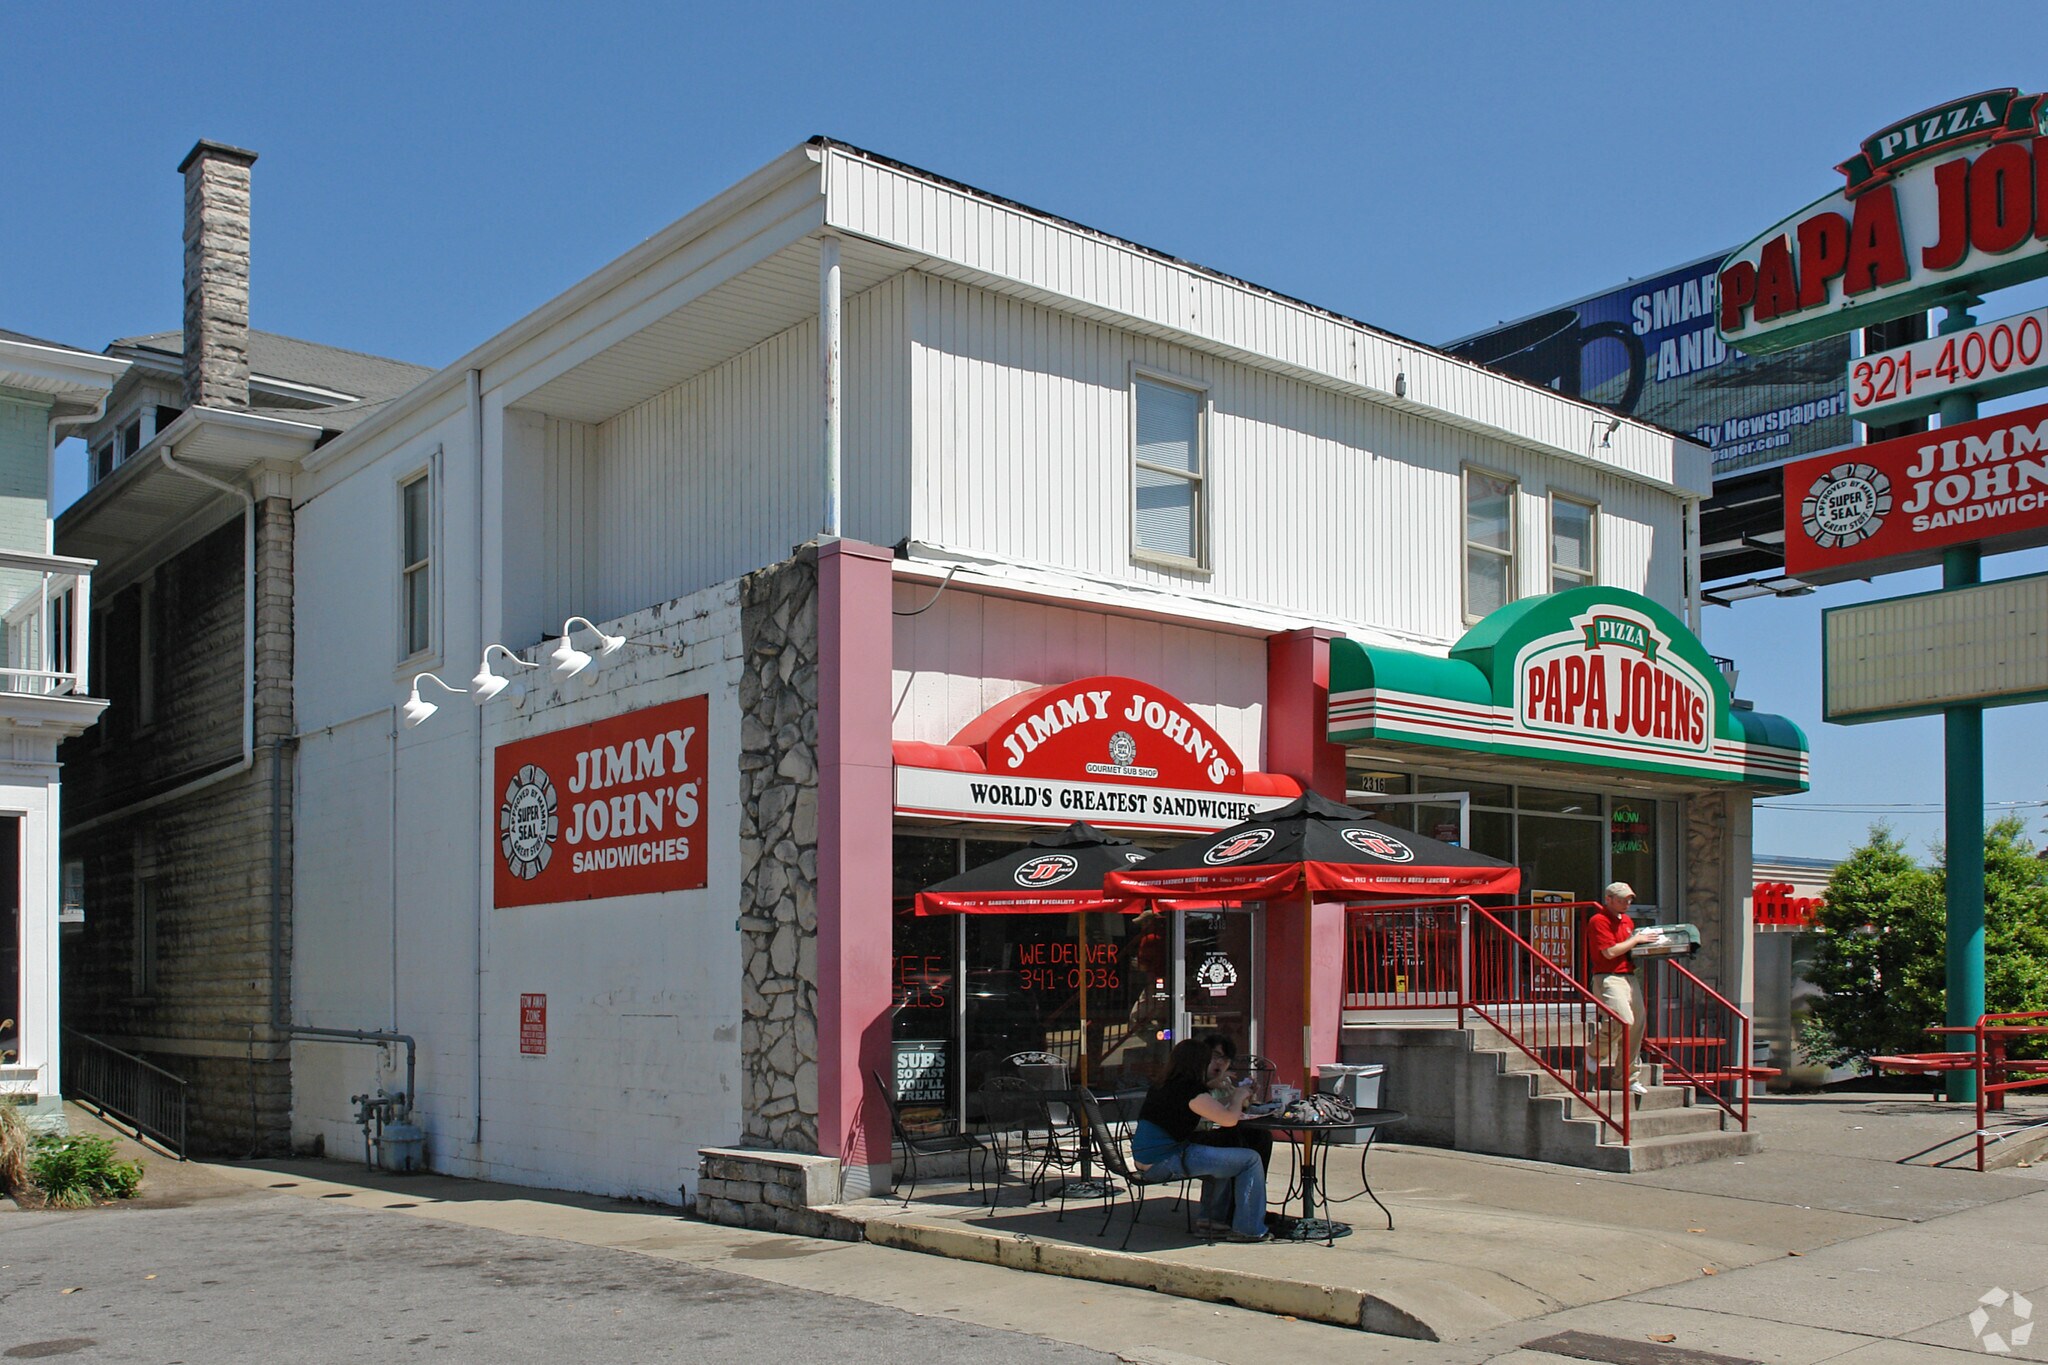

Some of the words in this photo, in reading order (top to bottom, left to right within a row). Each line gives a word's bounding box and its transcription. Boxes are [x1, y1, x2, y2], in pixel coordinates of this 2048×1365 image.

[1877, 101, 1996, 160] PIZZA
[1721, 184, 1910, 333] PAPA
[1657, 327, 1727, 381] AND
[1853, 316, 2042, 406] 321-4000
[1725, 391, 1846, 441] Newspaper!
[1819, 481, 1847, 516] APPROVED
[1829, 492, 1862, 508] SUPER
[1831, 505, 1861, 520] SEAL
[1824, 521, 1847, 532] GREAT
[1599, 621, 1644, 646] PIZZA
[1528, 655, 1608, 730] PAPA
[1614, 657, 1704, 745] JOHN'S
[1002, 690, 1111, 769] JIMMY
[1124, 694, 1229, 785] JOHN'S
[569, 726, 696, 794] JIMMY
[1087, 764, 1120, 774] GOURMET
[1138, 769, 1157, 777] SHOP
[1363, 777, 1385, 792] 2316
[970, 783, 1052, 807] WORLD'S
[1060, 789, 1147, 813] GREATEST
[511, 788, 530, 833] APPROVED
[530, 788, 538, 798] BY
[517, 805, 539, 823] SUPER
[565, 782, 699, 845] JOHN'S
[1614, 811, 1639, 823] NOW
[518, 823, 538, 840] SEAL
[514, 840, 529, 857] GREAT
[572, 837, 689, 874] SANDWICHES
[1019, 943, 1046, 965] WE
[1051, 942, 1119, 965] DELVER
[1019, 968, 1120, 990] 341-0036
[525, 1009, 541, 1023] ZONE
[897, 1052, 946, 1069] SUBS
[897, 1069, 913, 1079] SO
[915, 1068, 945, 1079] FAST
[897, 1090, 945, 1101] FREAK!
[898, 1079, 945, 1091] YOU'LL
